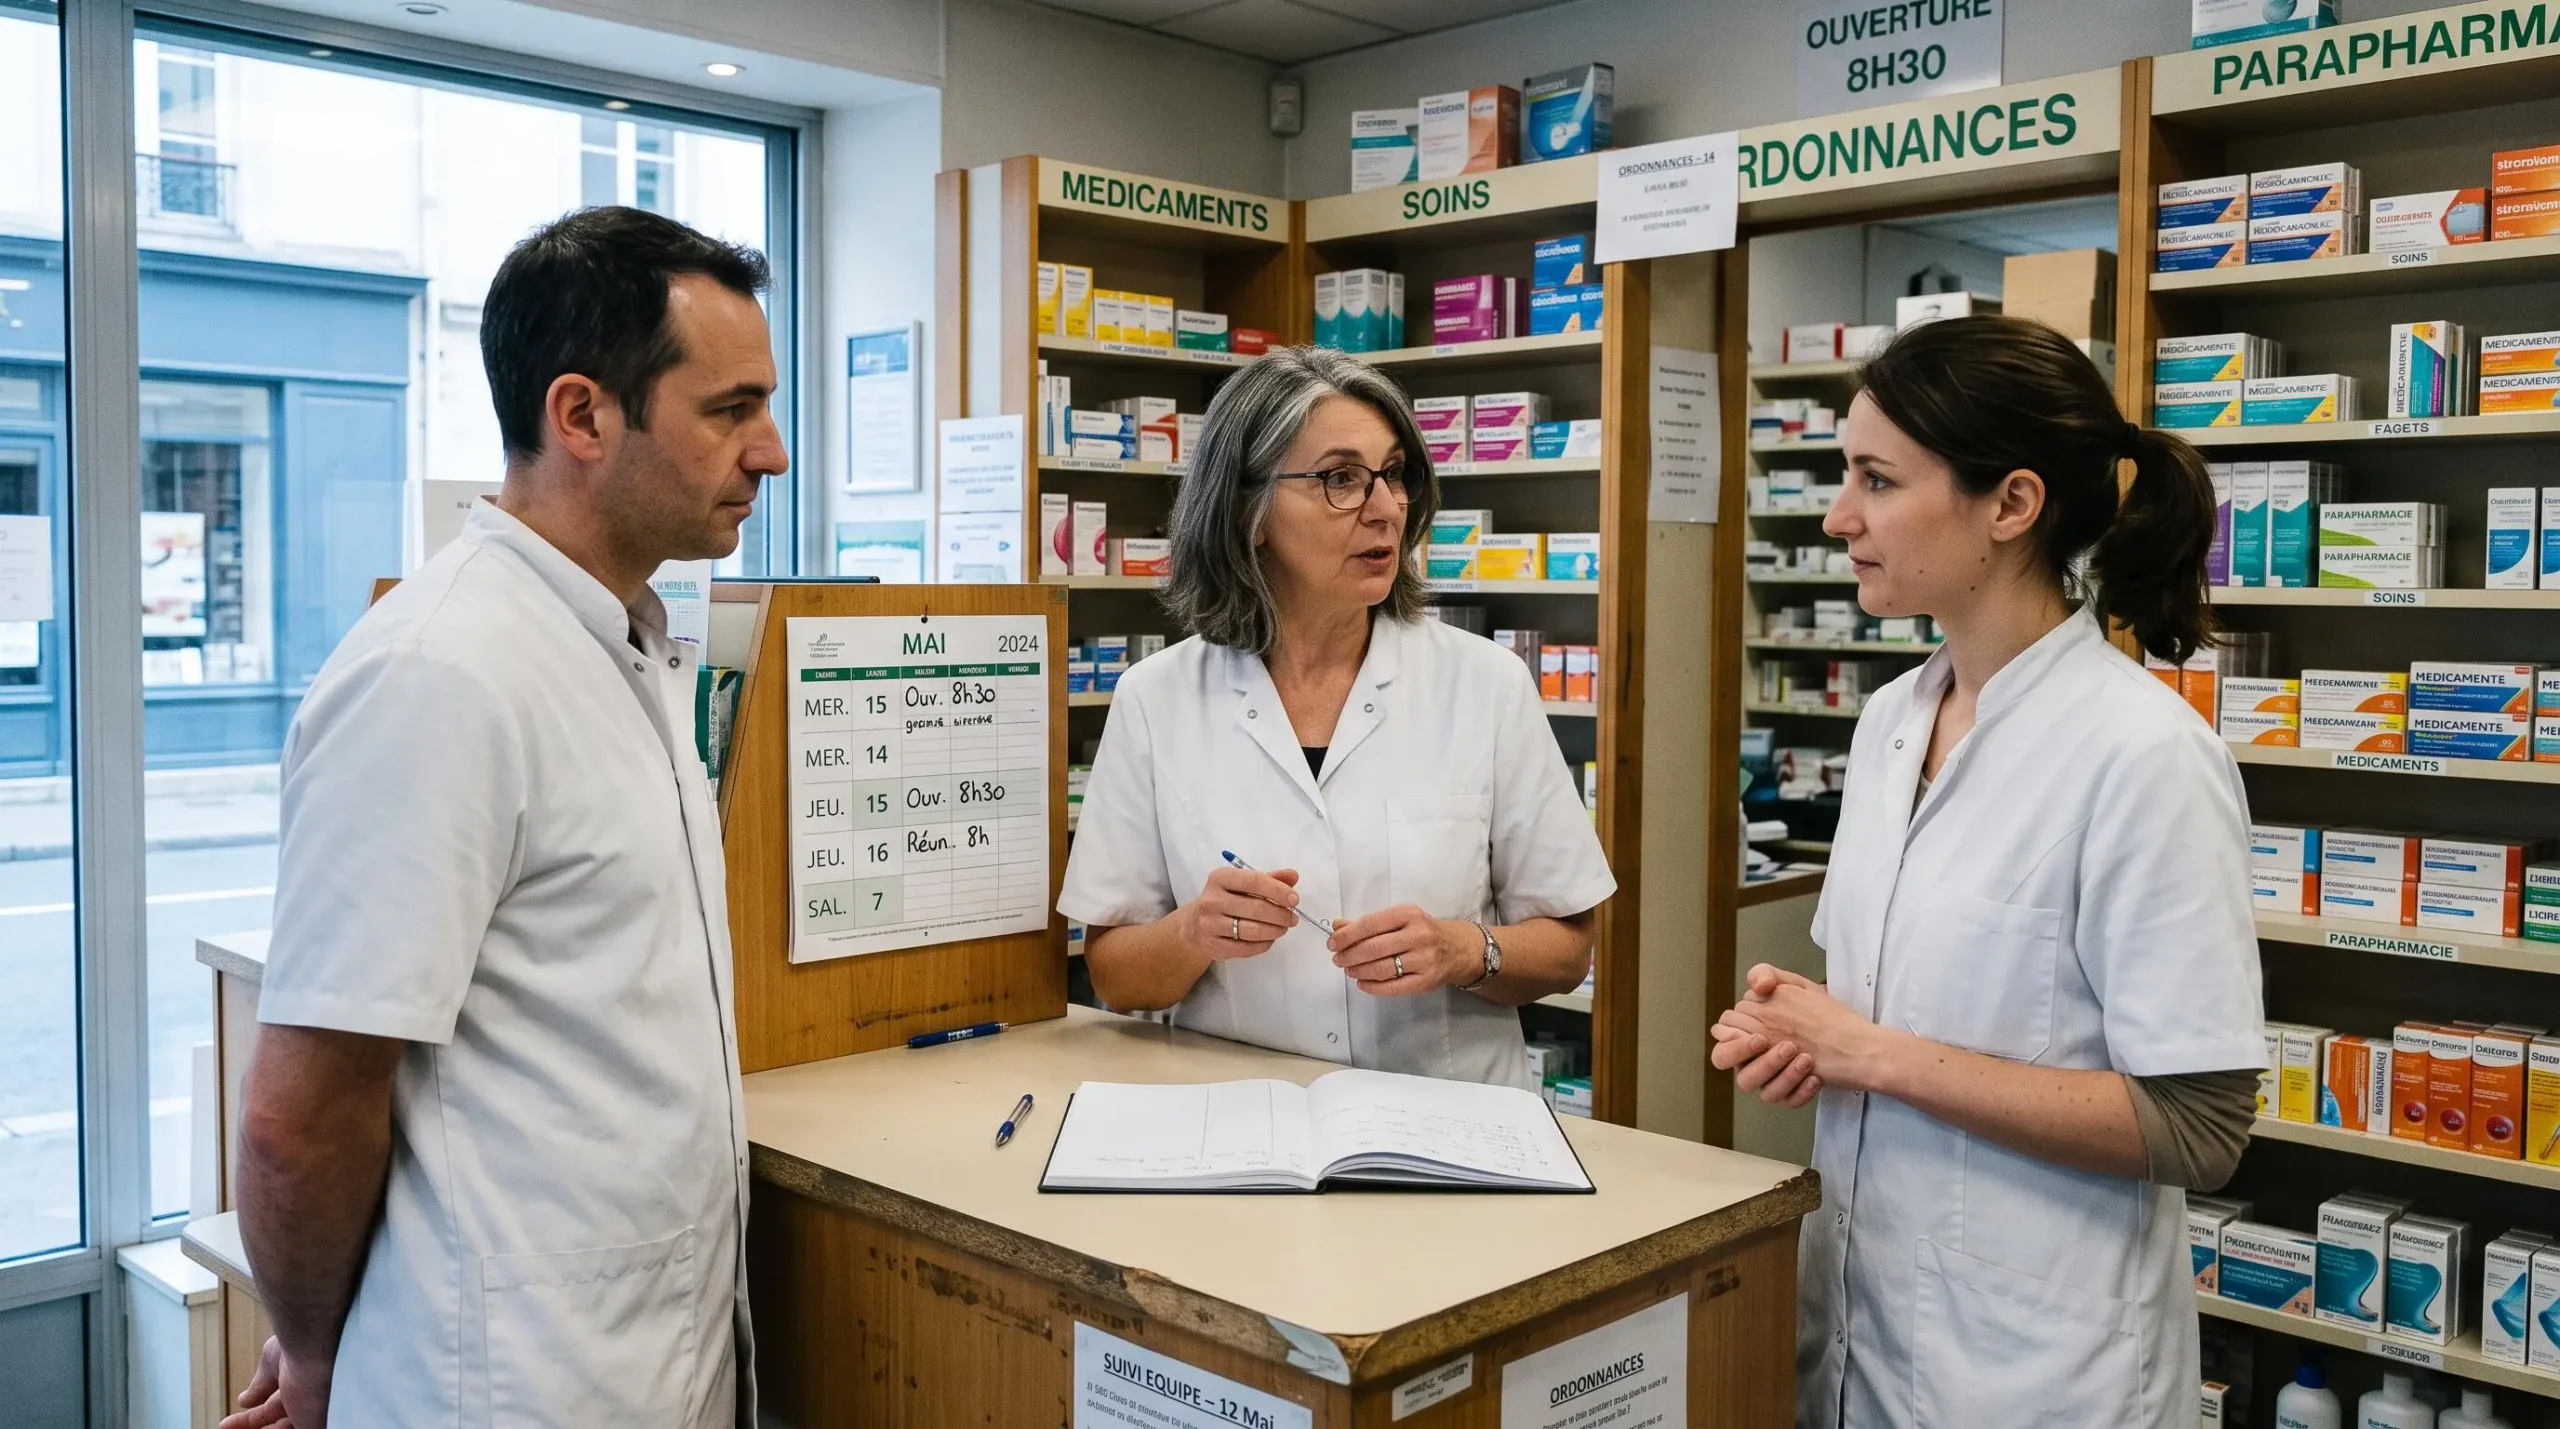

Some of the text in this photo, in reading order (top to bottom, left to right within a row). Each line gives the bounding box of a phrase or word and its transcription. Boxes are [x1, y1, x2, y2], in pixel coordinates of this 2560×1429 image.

[1806, 0, 1992, 49] OUVERTURE
[1847, 44, 1946, 93] 8H30
[1739, 93, 2077, 189] RDONNANCES
[1619, 154, 1693, 177] ORDONNANCES
[1062, 170, 1269, 232] MEDICAMENTS
[1402, 180, 1490, 220] SOINS
[2391, 252, 2428, 265] SOINS
[2324, 509, 2413, 520] PARAPHARMACIE
[2324, 552, 2412, 562] PARAPHARMACIE
[2373, 592, 2416, 604] SOINS
[902, 632, 1039, 655] MAI 2024
[2415, 672, 2506, 684] MEDICAMENTE
[905, 681, 996, 707] Ouv. 8h30
[804, 695, 887, 717] MER. 15
[2414, 719, 2504, 733] MEDICAMENTS
[2540, 726, 2560, 736] ME
[805, 745, 888, 768] MER. 14
[2337, 755, 2439, 772] MEDICAMENTS
[806, 794, 888, 818] JEU. 15
[906, 780, 1005, 809] Ouv. 8h30
[967, 825, 990, 848] 8h
[807, 843, 889, 869] JEU. 16
[808, 892, 884, 918] SAL. 7
[2330, 933, 2453, 958] PARAPHARMACIE
[1550, 1352, 1644, 1405] ORDONNANCES
[1103, 1352, 1142, 1383] SUIVI
[1146, 1369, 1201, 1406] EQUIPE
[1219, 1398, 1238, 1420] 12
[1243, 1406, 1275, 1429] Mai
